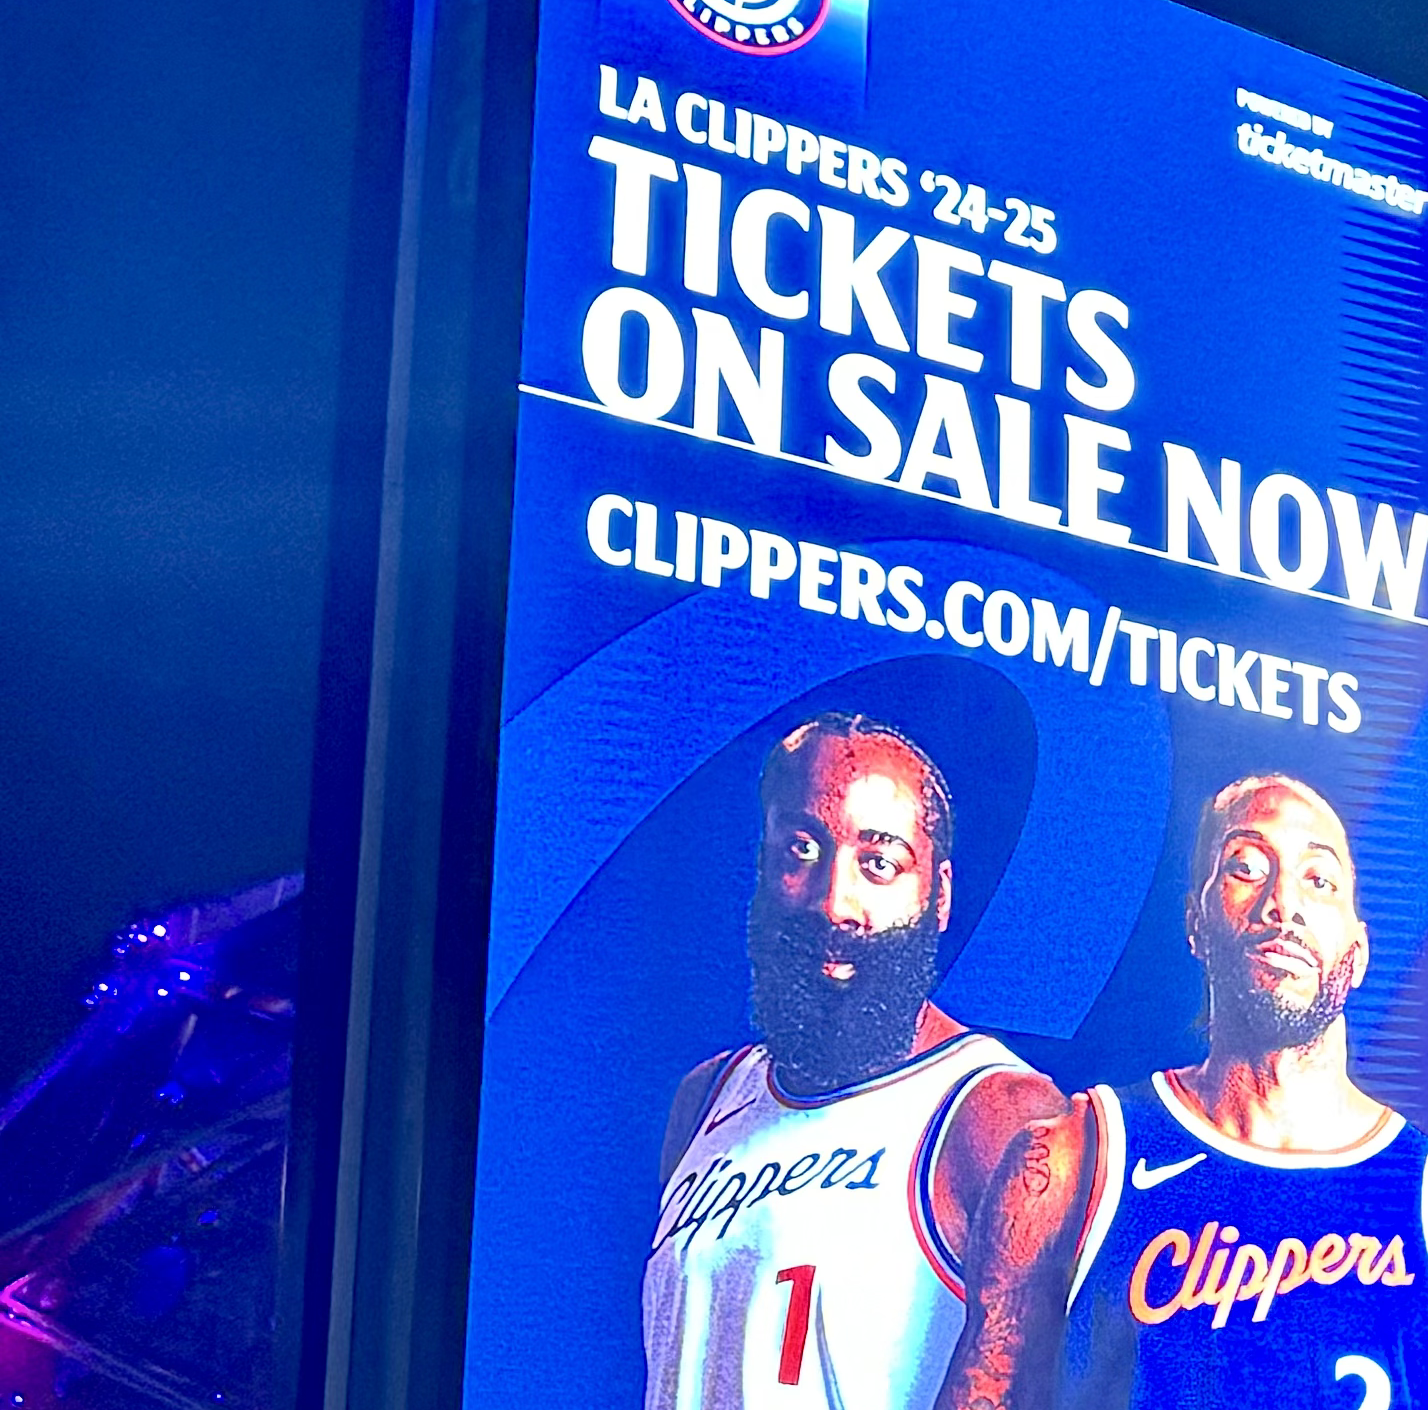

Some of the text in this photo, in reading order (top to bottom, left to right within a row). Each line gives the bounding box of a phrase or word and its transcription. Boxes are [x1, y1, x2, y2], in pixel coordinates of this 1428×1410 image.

[598, 63, 667, 133] LA
[674, 90, 910, 208] CLIPPERS
[587, 135, 1136, 413] TICKETS
[581, 286, 785, 455] ON
[823, 351, 1134, 541] SALE
[585, 493, 1364, 736] CLIPPERS.COM/TICKETS
[650, 1146, 887, 1259] Clippers
[775, 1264, 818, 1386] 1
[1128, 1221, 1416, 1330] Clippers
